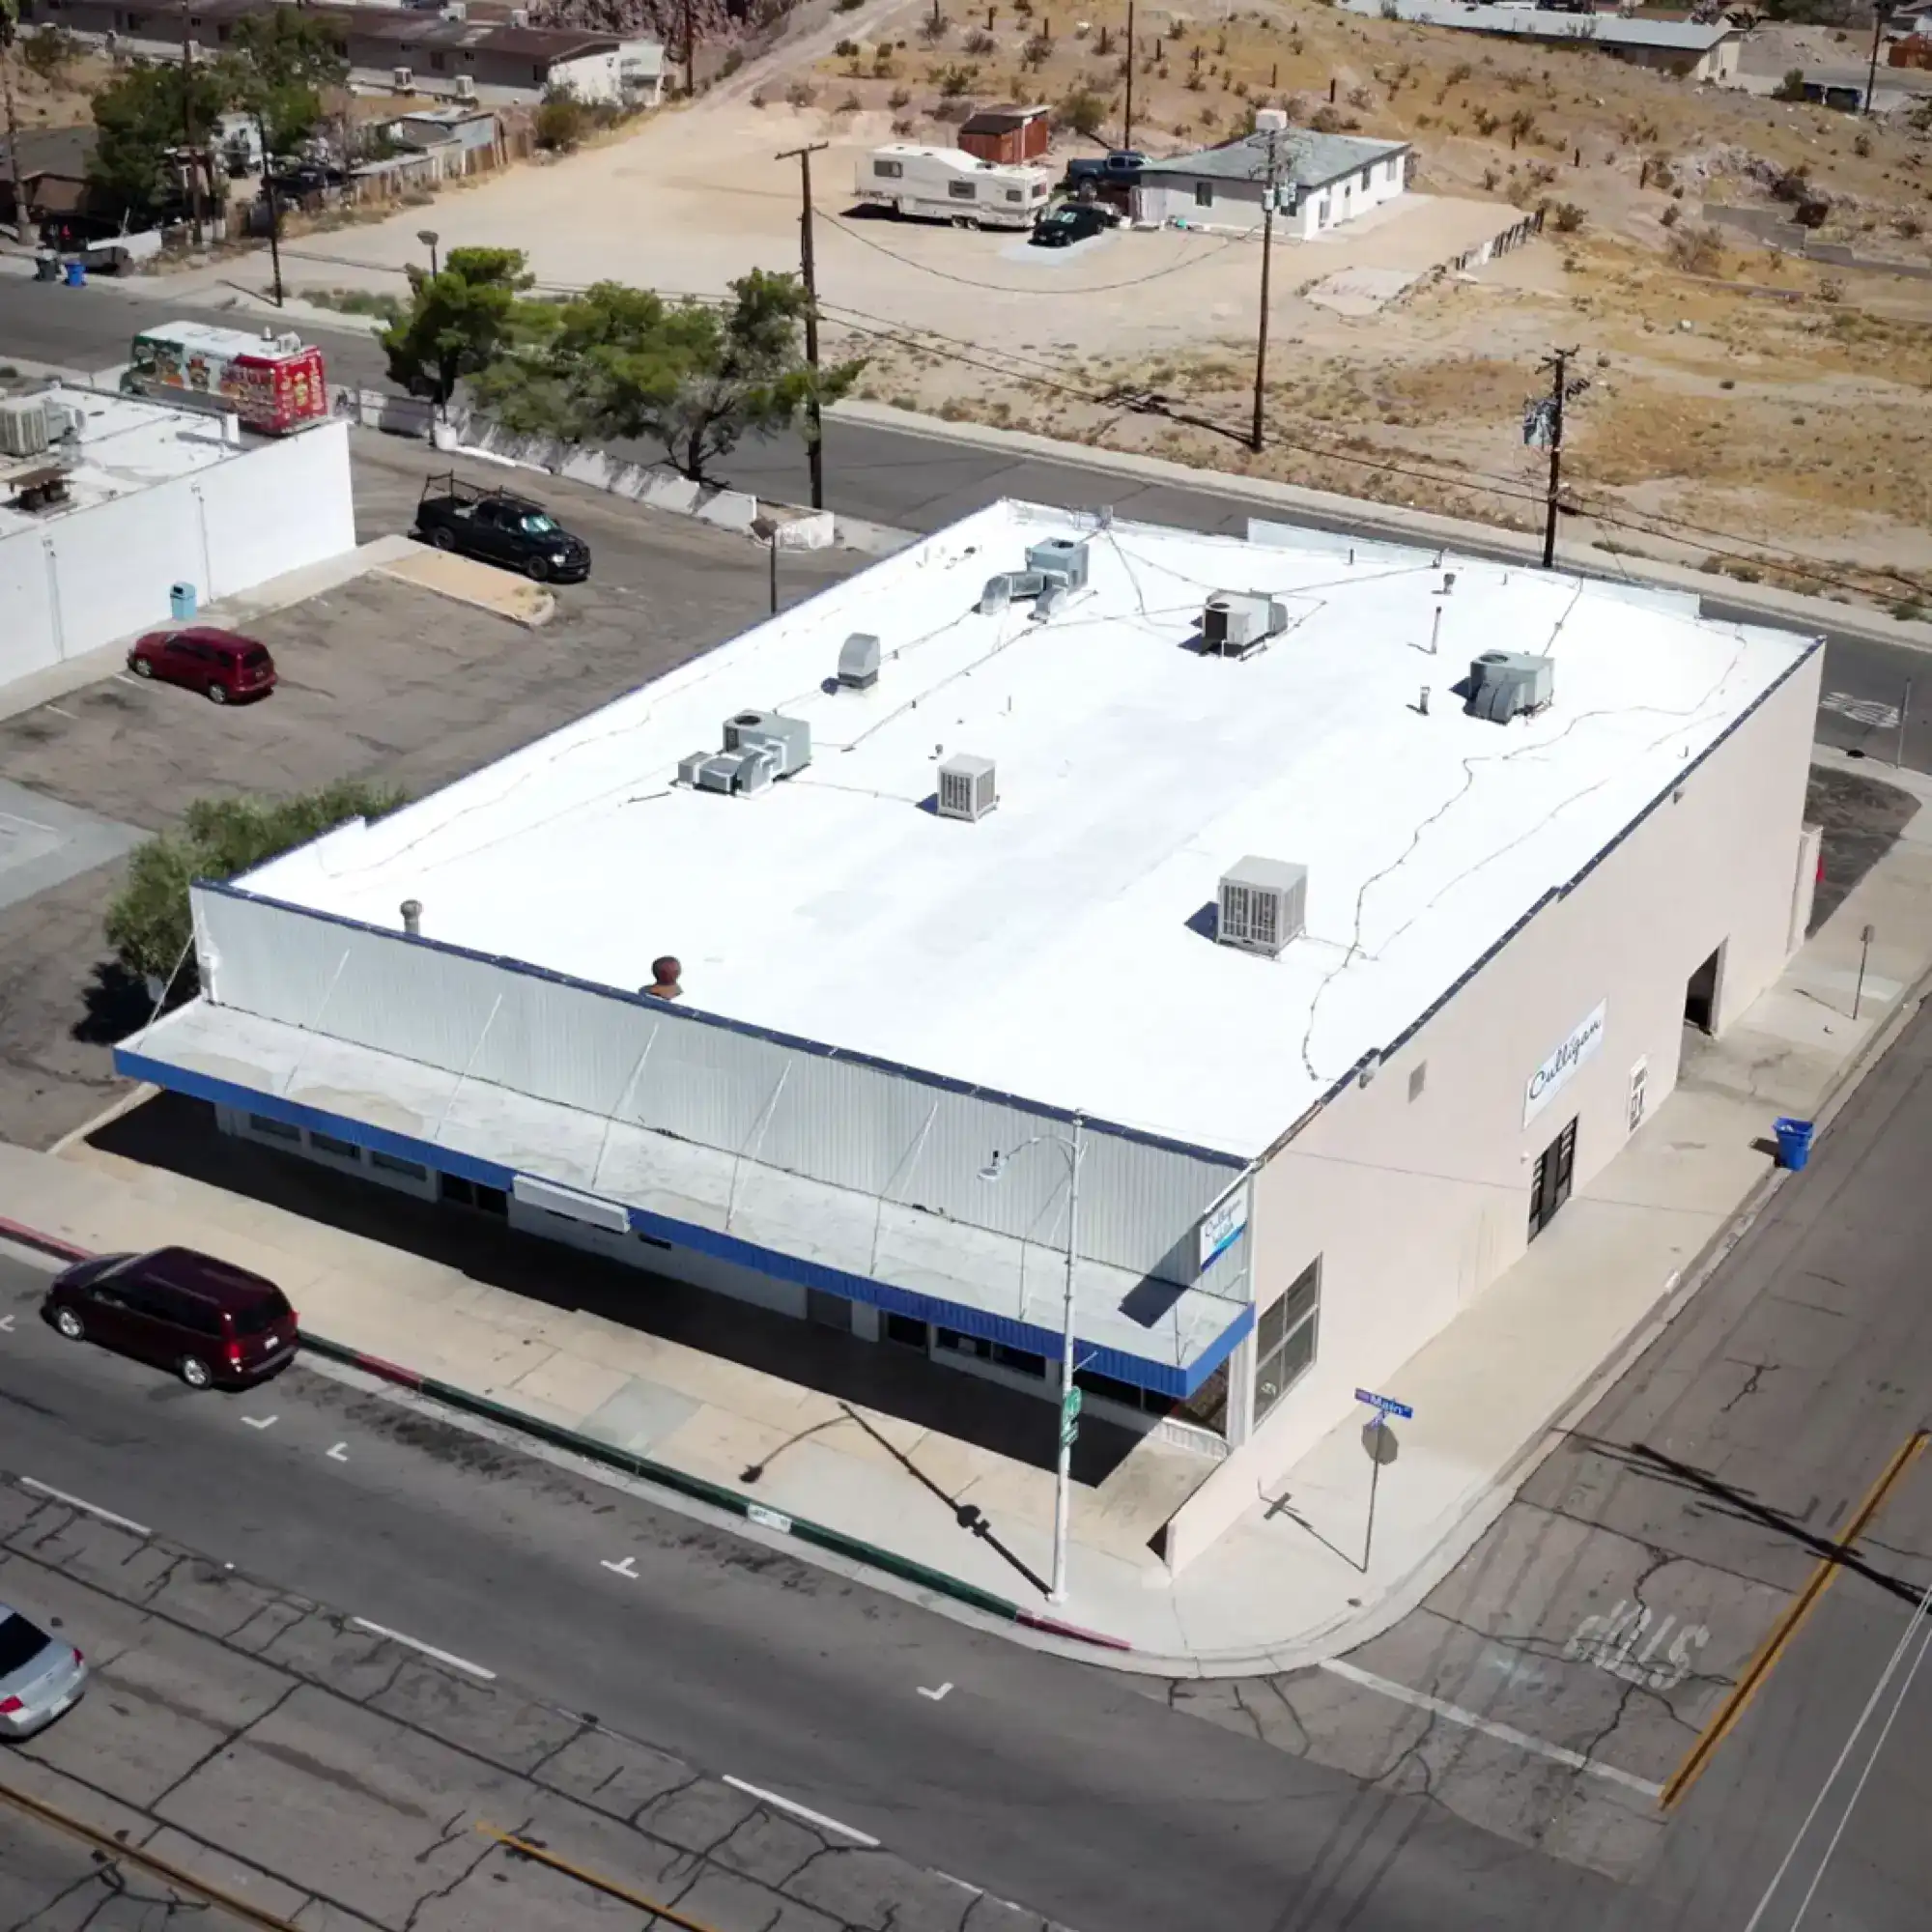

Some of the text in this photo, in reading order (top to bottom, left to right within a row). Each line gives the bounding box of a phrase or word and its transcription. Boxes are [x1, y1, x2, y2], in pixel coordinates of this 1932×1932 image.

[1529, 1019, 1602, 1100] Culligan
[1371, 1394, 1404, 1415] Main
[1562, 1599, 1711, 1691] STOP
